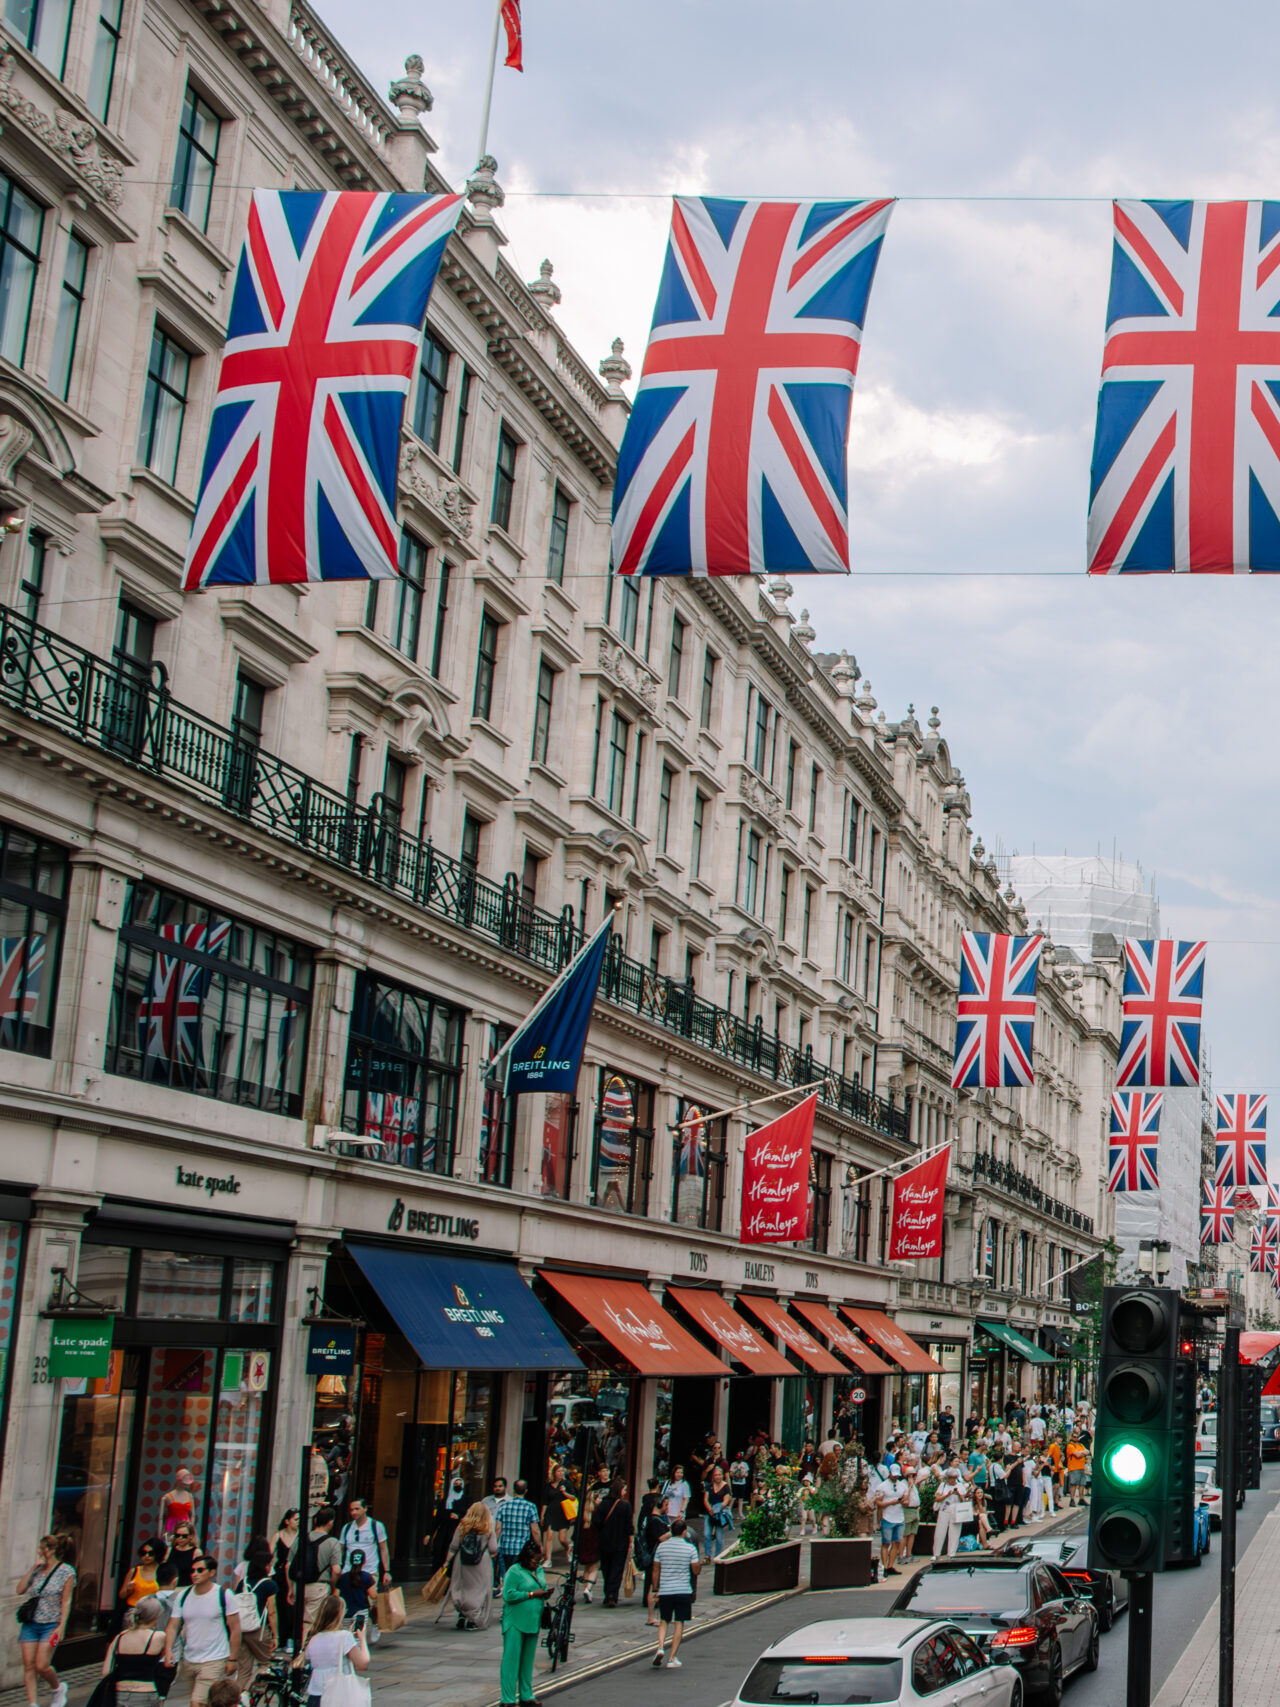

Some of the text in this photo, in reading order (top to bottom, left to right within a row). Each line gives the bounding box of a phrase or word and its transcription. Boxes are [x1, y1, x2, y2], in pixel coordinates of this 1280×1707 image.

[513, 1060, 570, 1072] BREITLING
[752, 1141, 803, 1169] Hamleys
[177, 1165, 241, 1198] kate spade
[749, 1174, 800, 1201] Hamleys
[899, 1183, 939, 1205] Hamleys
[407, 1209, 479, 1240] BREITLING
[748, 1208, 799, 1235] Hamleys
[896, 1207, 937, 1228] Hamleys
[895, 1233, 936, 1254] Hamleys
[690, 1251, 819, 1288] TOYS HAMLEYS TOYS
[444, 1307, 505, 1324] BREITLING
[1076, 1301, 1100, 1311] BO
[54, 1336, 109, 1349] kate spade
[312, 1347, 352, 1356] BREITLING
[854, 1391, 865, 1399] 20
